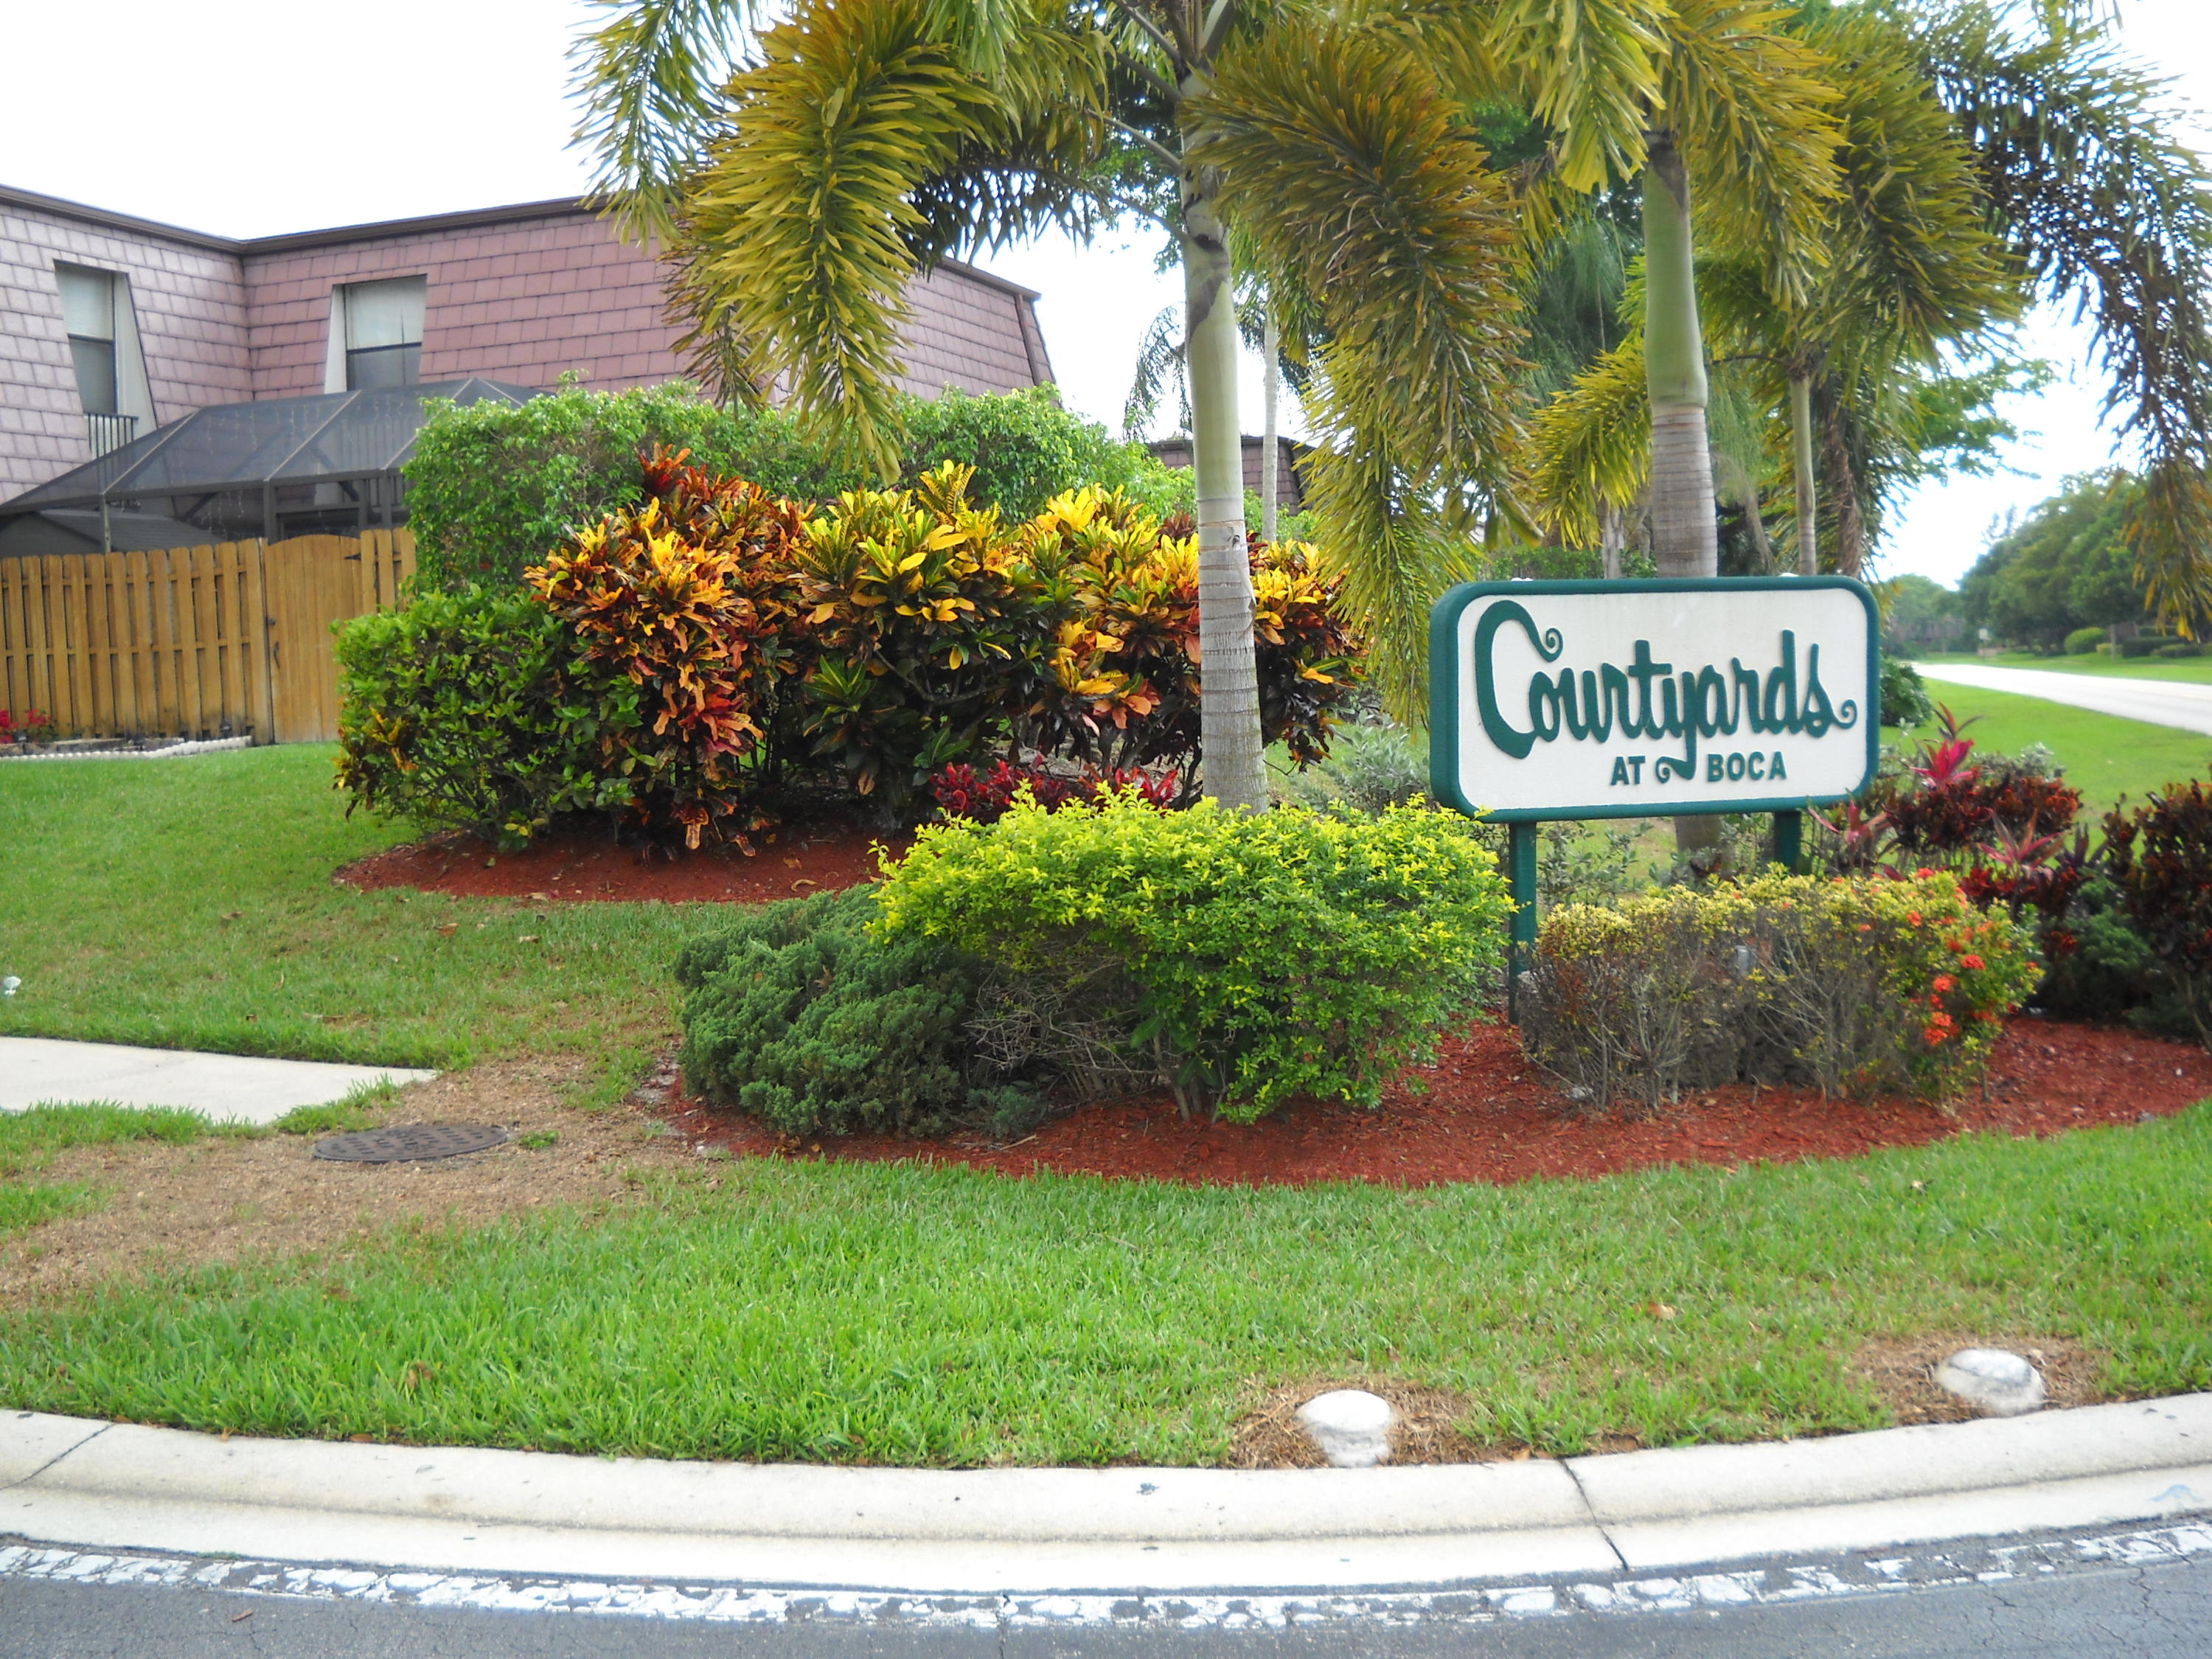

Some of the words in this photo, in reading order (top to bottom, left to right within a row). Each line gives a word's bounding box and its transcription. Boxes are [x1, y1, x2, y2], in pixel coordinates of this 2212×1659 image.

[1475, 599, 1857, 784] Courtyards
[1610, 756, 1646, 786] AT
[1707, 751, 1787, 782] BOCA
